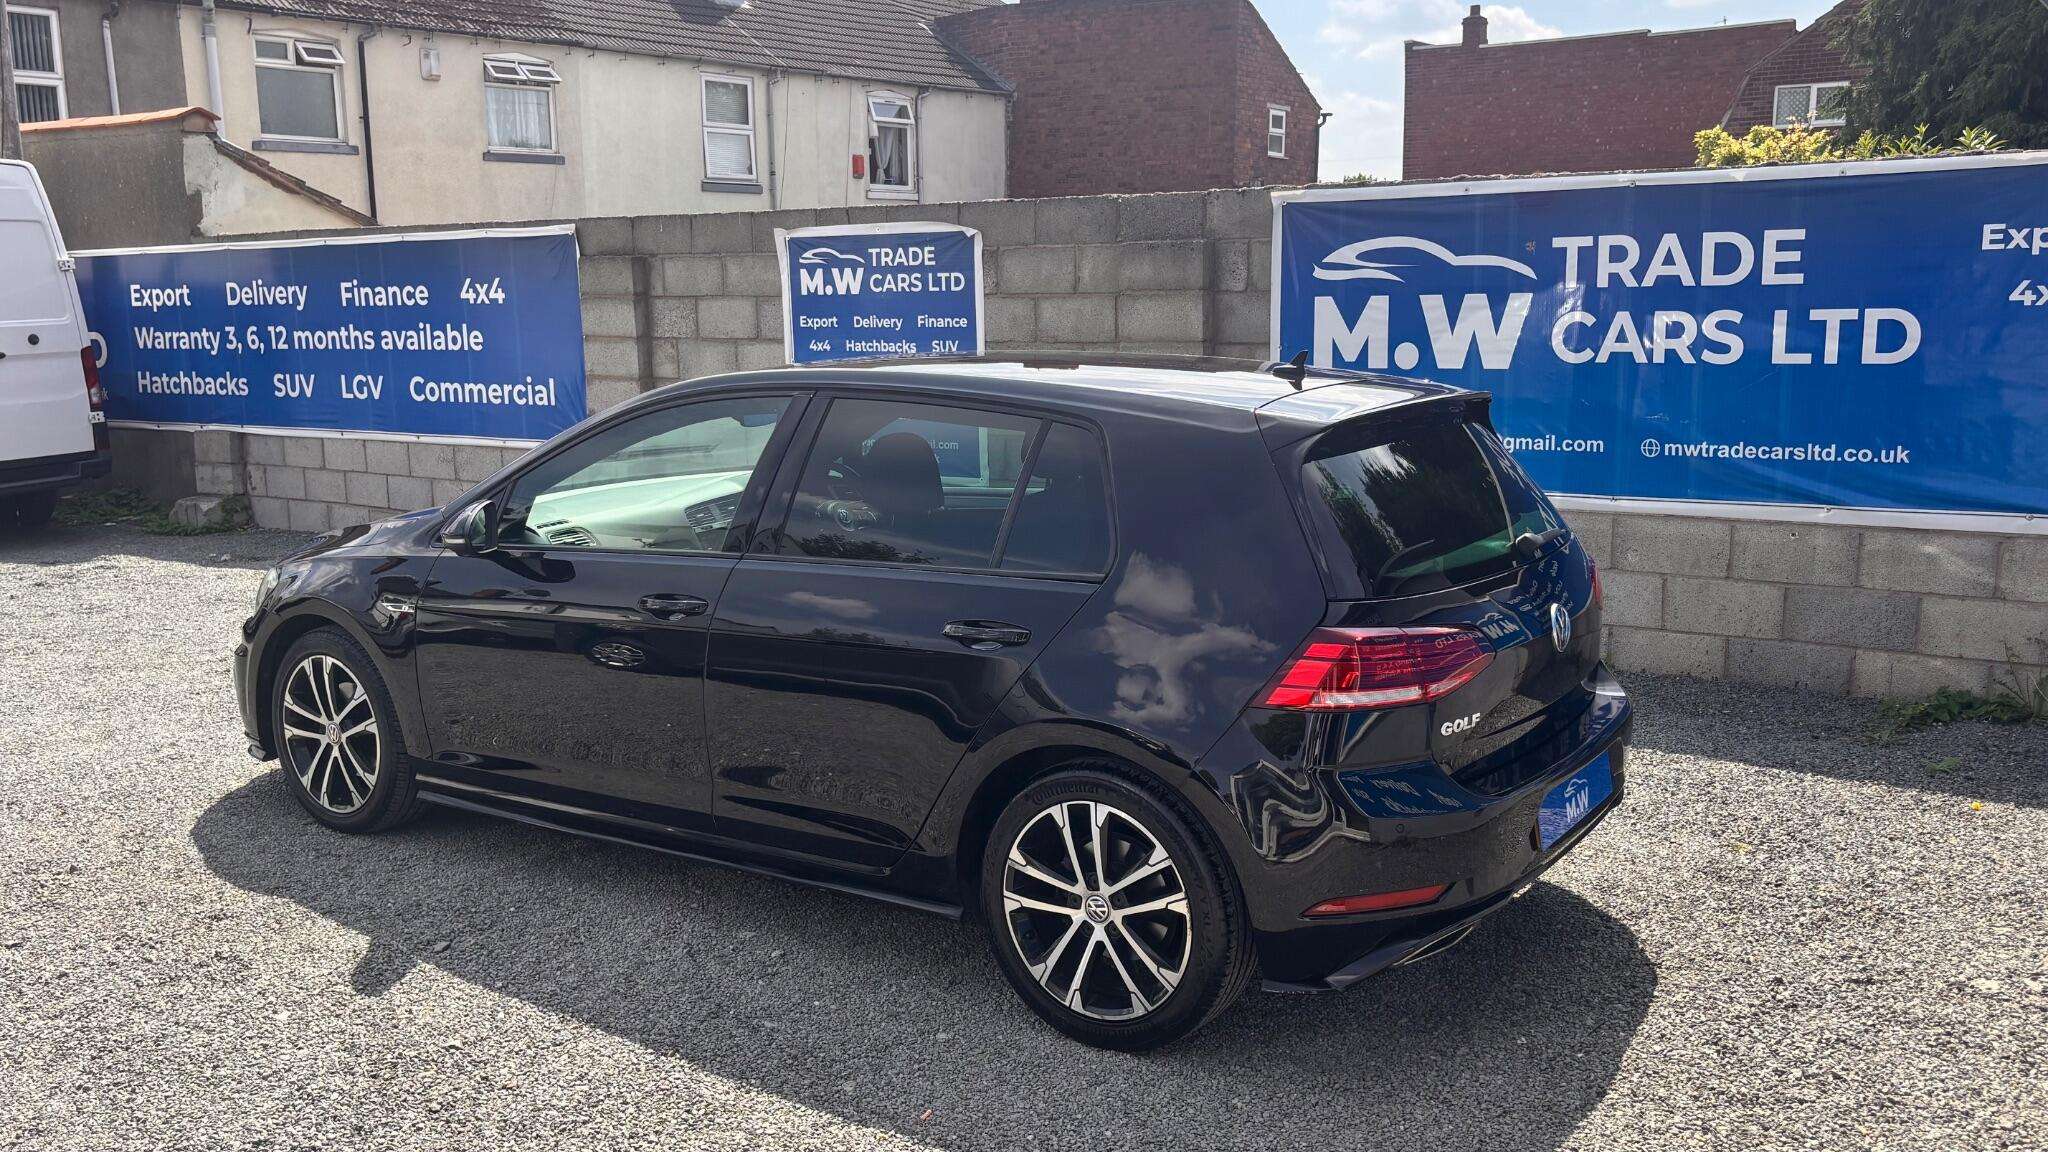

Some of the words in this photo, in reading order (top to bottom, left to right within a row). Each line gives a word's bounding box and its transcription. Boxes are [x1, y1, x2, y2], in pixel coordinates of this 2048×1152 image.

[868, 246, 936, 266] TRADE
[1552, 229, 1806, 288] TRADE
[130, 284, 191, 312] Export
[226, 279, 307, 310] Delivery
[340, 279, 428, 307] Finance
[460, 277, 505, 304] 4x4
[800, 267, 865, 295] M.W
[869, 272, 922, 292] CARS
[929, 271, 966, 291] LTD
[800, 314, 838, 330] Export
[853, 314, 904, 331] Delivery
[917, 314, 968, 328] Finance
[1313, 293, 1534, 370] M.W
[1551, 309, 1745, 365] CARS
[1772, 308, 1922, 365] LTD
[134, 327, 220, 355] Warranty
[225, 326, 242, 353] 3,
[246, 326, 264, 354] 6,
[268, 326, 288, 349] 12
[293, 324, 375, 350] months
[381, 322, 484, 351] available
[809, 339, 832, 352] 4x4
[846, 339, 917, 354] Hatchbacks
[932, 340, 959, 352] SUV
[138, 371, 249, 396] Hatchbacks
[273, 373, 315, 397] SUV
[341, 375, 384, 399] LGV
[409, 376, 556, 406] Commercial
[1664, 441, 1911, 463] mwtradecarsltd.co.uk
[1441, 712, 1480, 736] GOLF
[1565, 786, 1589, 823] M.W
